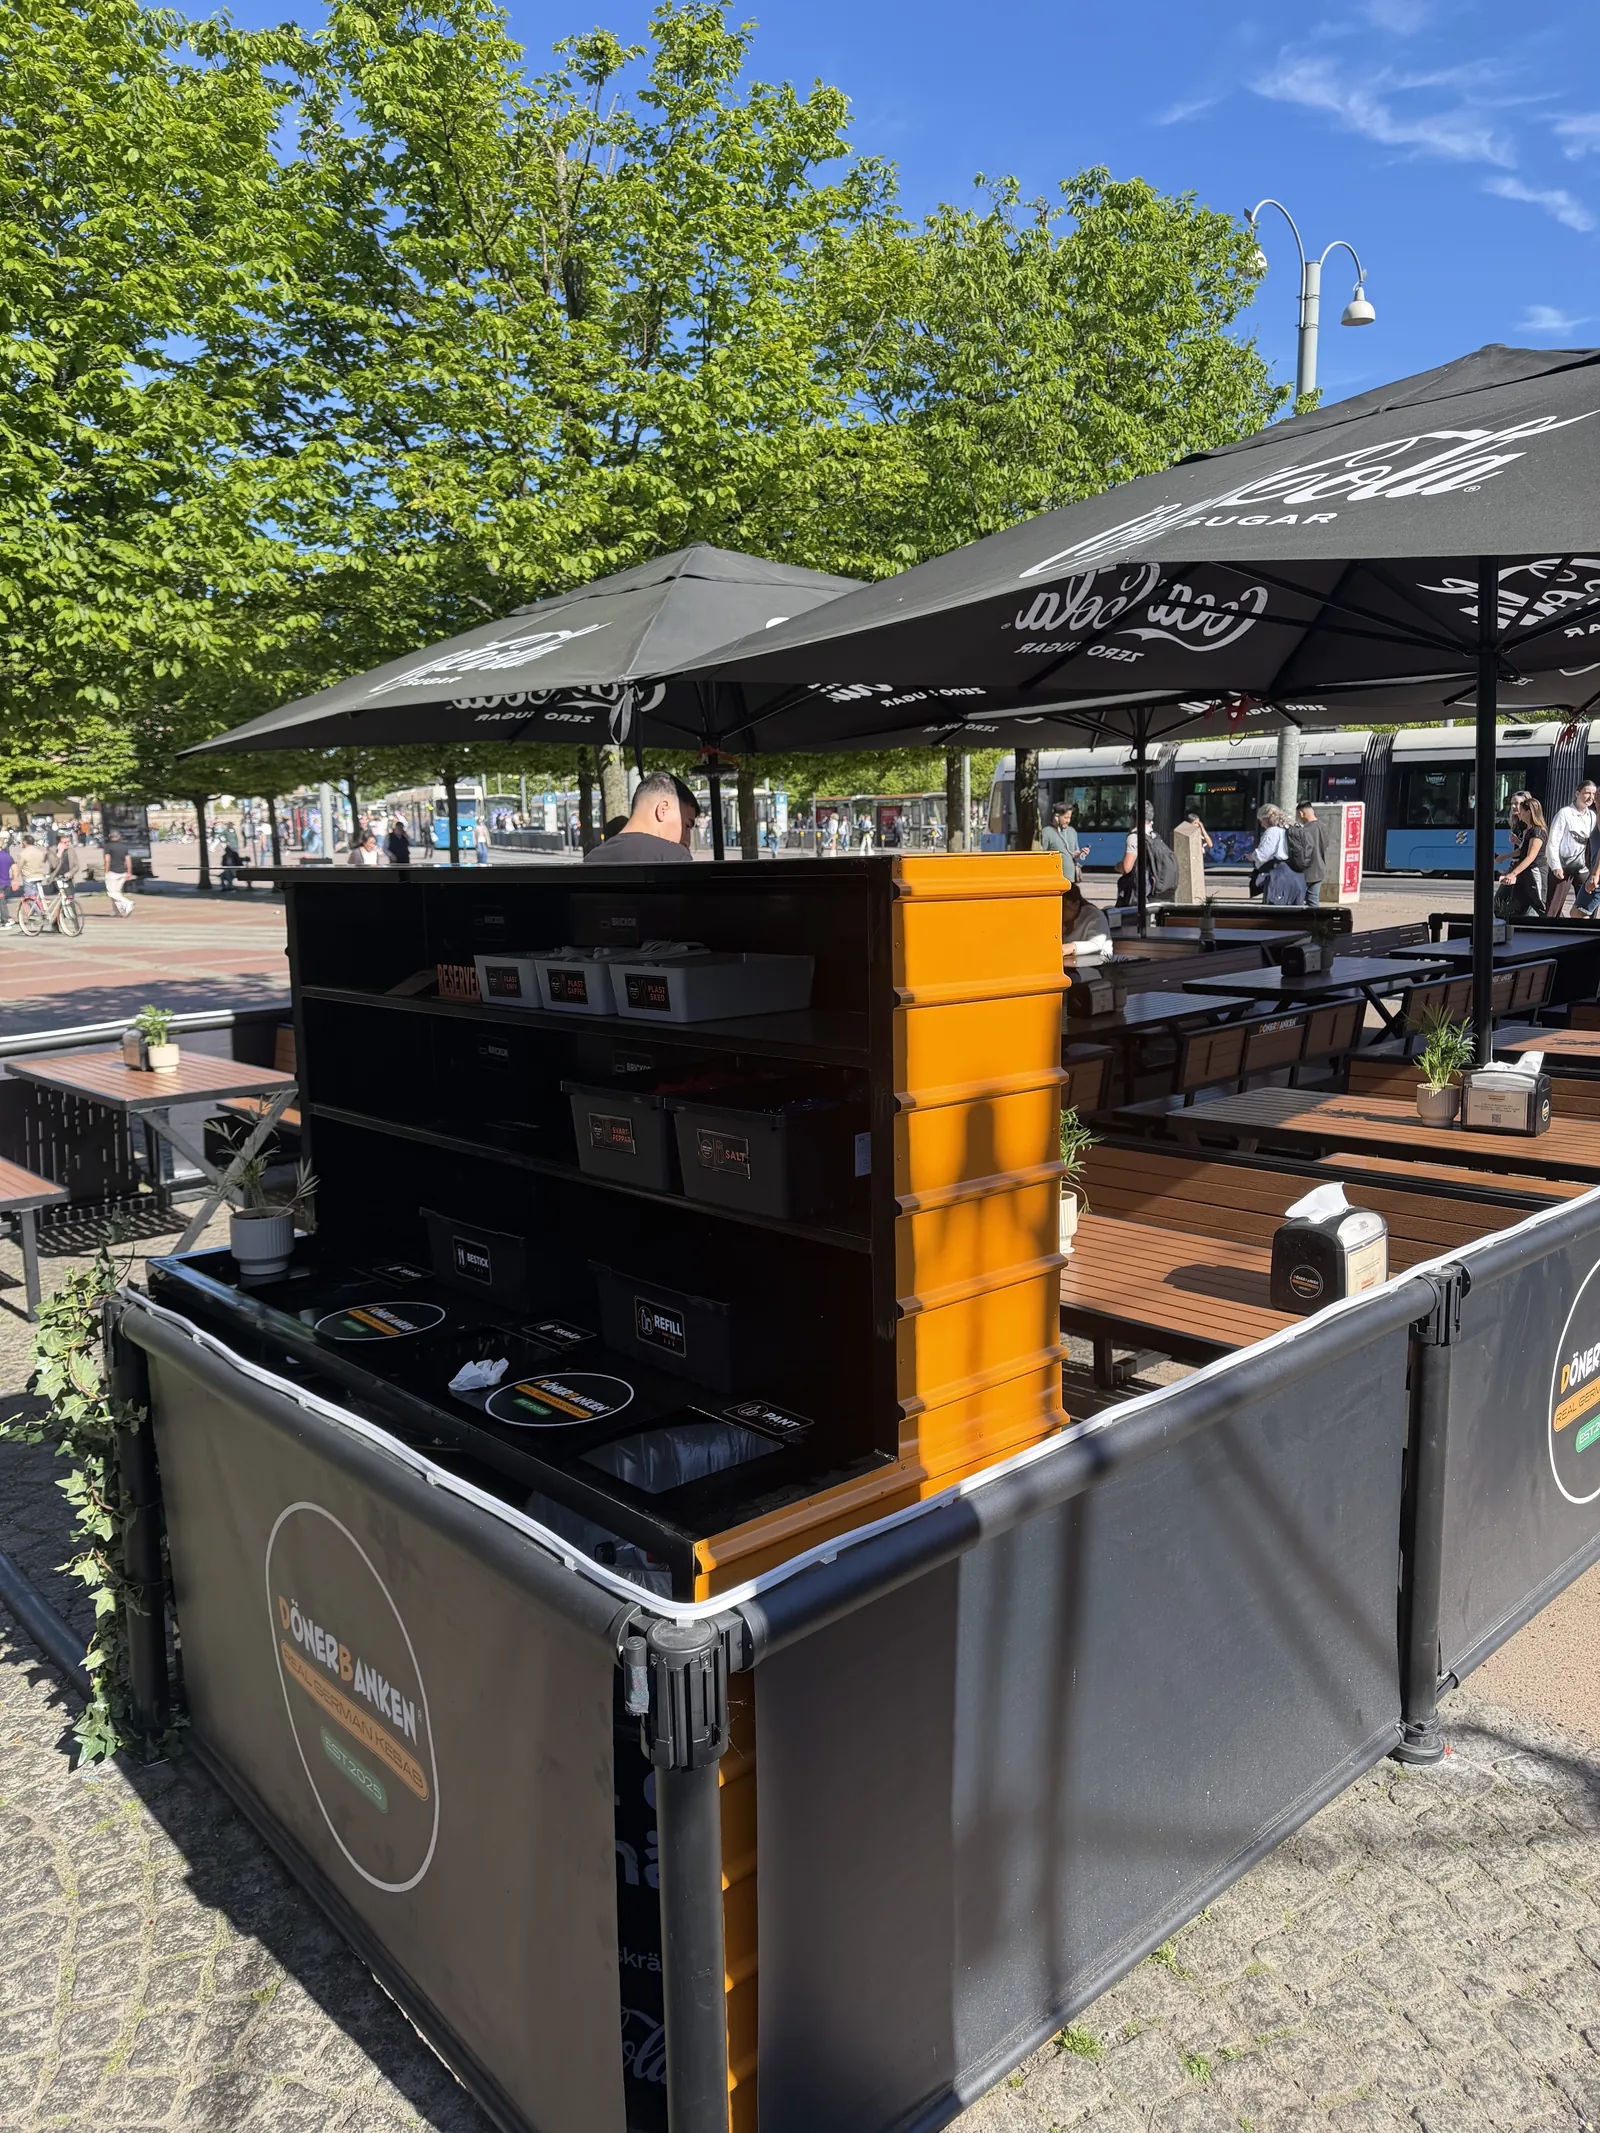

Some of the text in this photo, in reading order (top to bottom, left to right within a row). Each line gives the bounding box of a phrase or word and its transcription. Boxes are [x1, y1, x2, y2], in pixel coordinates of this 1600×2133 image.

[567, 979, 584, 989] PLAST
[647, 985, 666, 995] PLAST
[650, 993, 665, 1002] SKED
[724, 1149, 746, 1162] SALT
[466, 1252, 490, 1269] BESTICK
[653, 1314, 683, 1337] REFILL
[762, 1411, 801, 1429] PANT
[1556, 1402, 1577, 1424] REAL
[278, 1595, 417, 1747] DÖNERBANKEN
[283, 1649, 424, 1790] REAL GERMAN KEBAB
